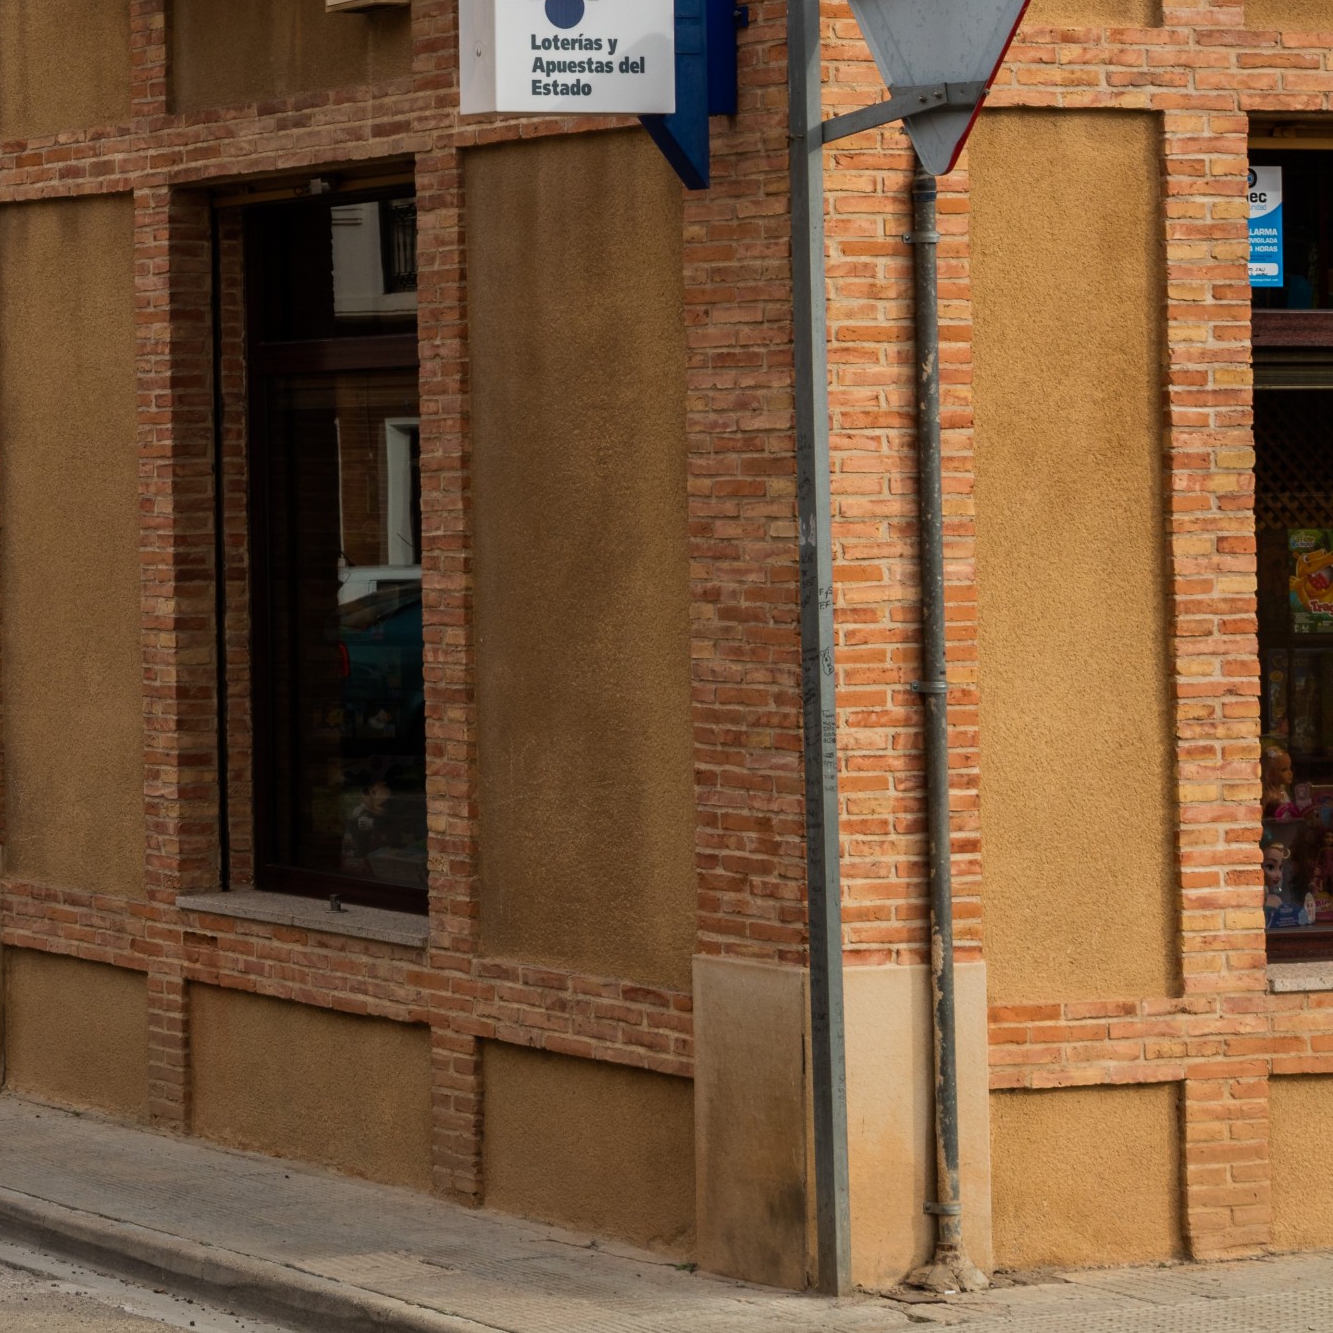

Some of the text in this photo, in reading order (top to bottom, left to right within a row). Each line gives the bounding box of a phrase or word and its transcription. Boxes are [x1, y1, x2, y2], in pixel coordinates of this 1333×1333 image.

[531, 33, 617, 55] Loterías y
[532, 57, 645, 77] Apuestas del
[531, 79, 593, 96] Estado
[1247, 192, 1267, 203] ec
[1249, 228, 1278, 236] LARMA
